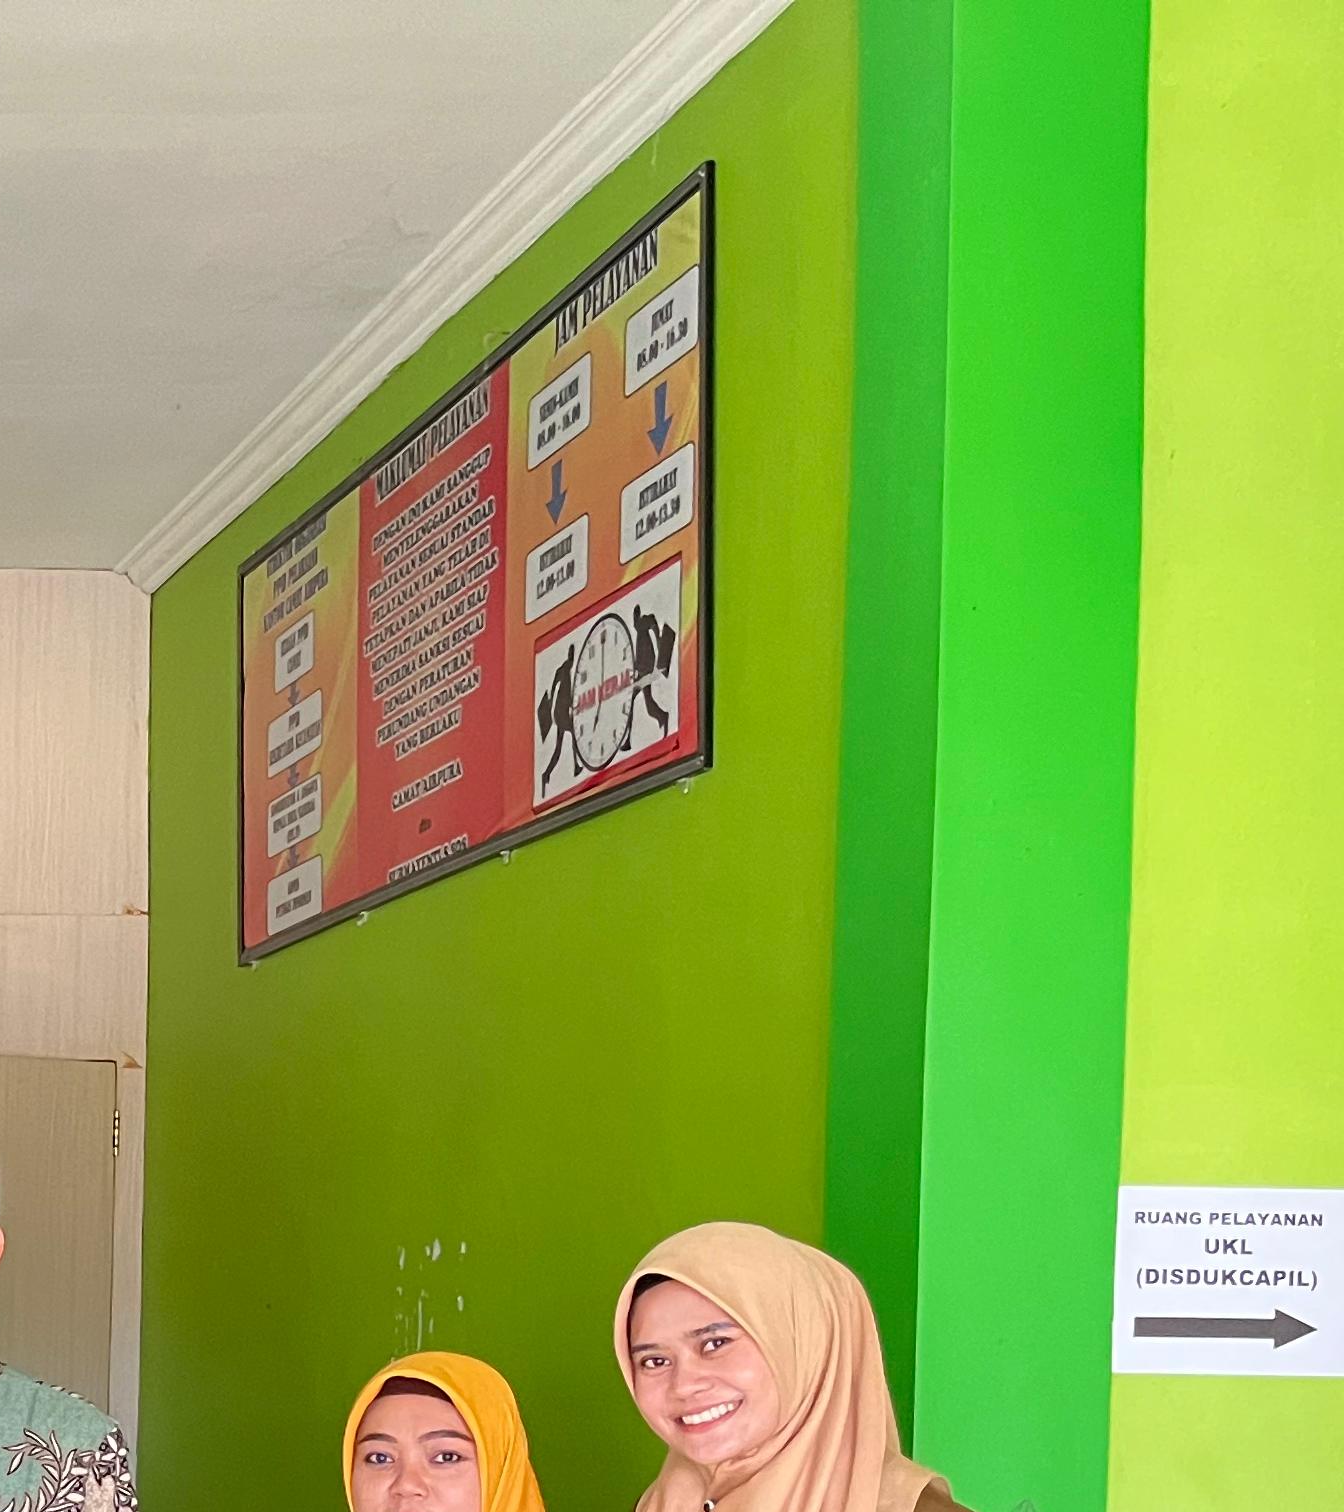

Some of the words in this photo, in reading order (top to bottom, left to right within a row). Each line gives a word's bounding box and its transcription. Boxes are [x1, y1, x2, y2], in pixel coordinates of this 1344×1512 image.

[583, 232, 657, 325] PELAYANAN
[1134, 1211, 1202, 1225] RUANG
[1209, 1212, 1323, 1227] PELAYANAN
[1204, 1238, 1253, 1255] UKL
[1136, 1268, 1318, 1291] (DISDUKCAPIL)
